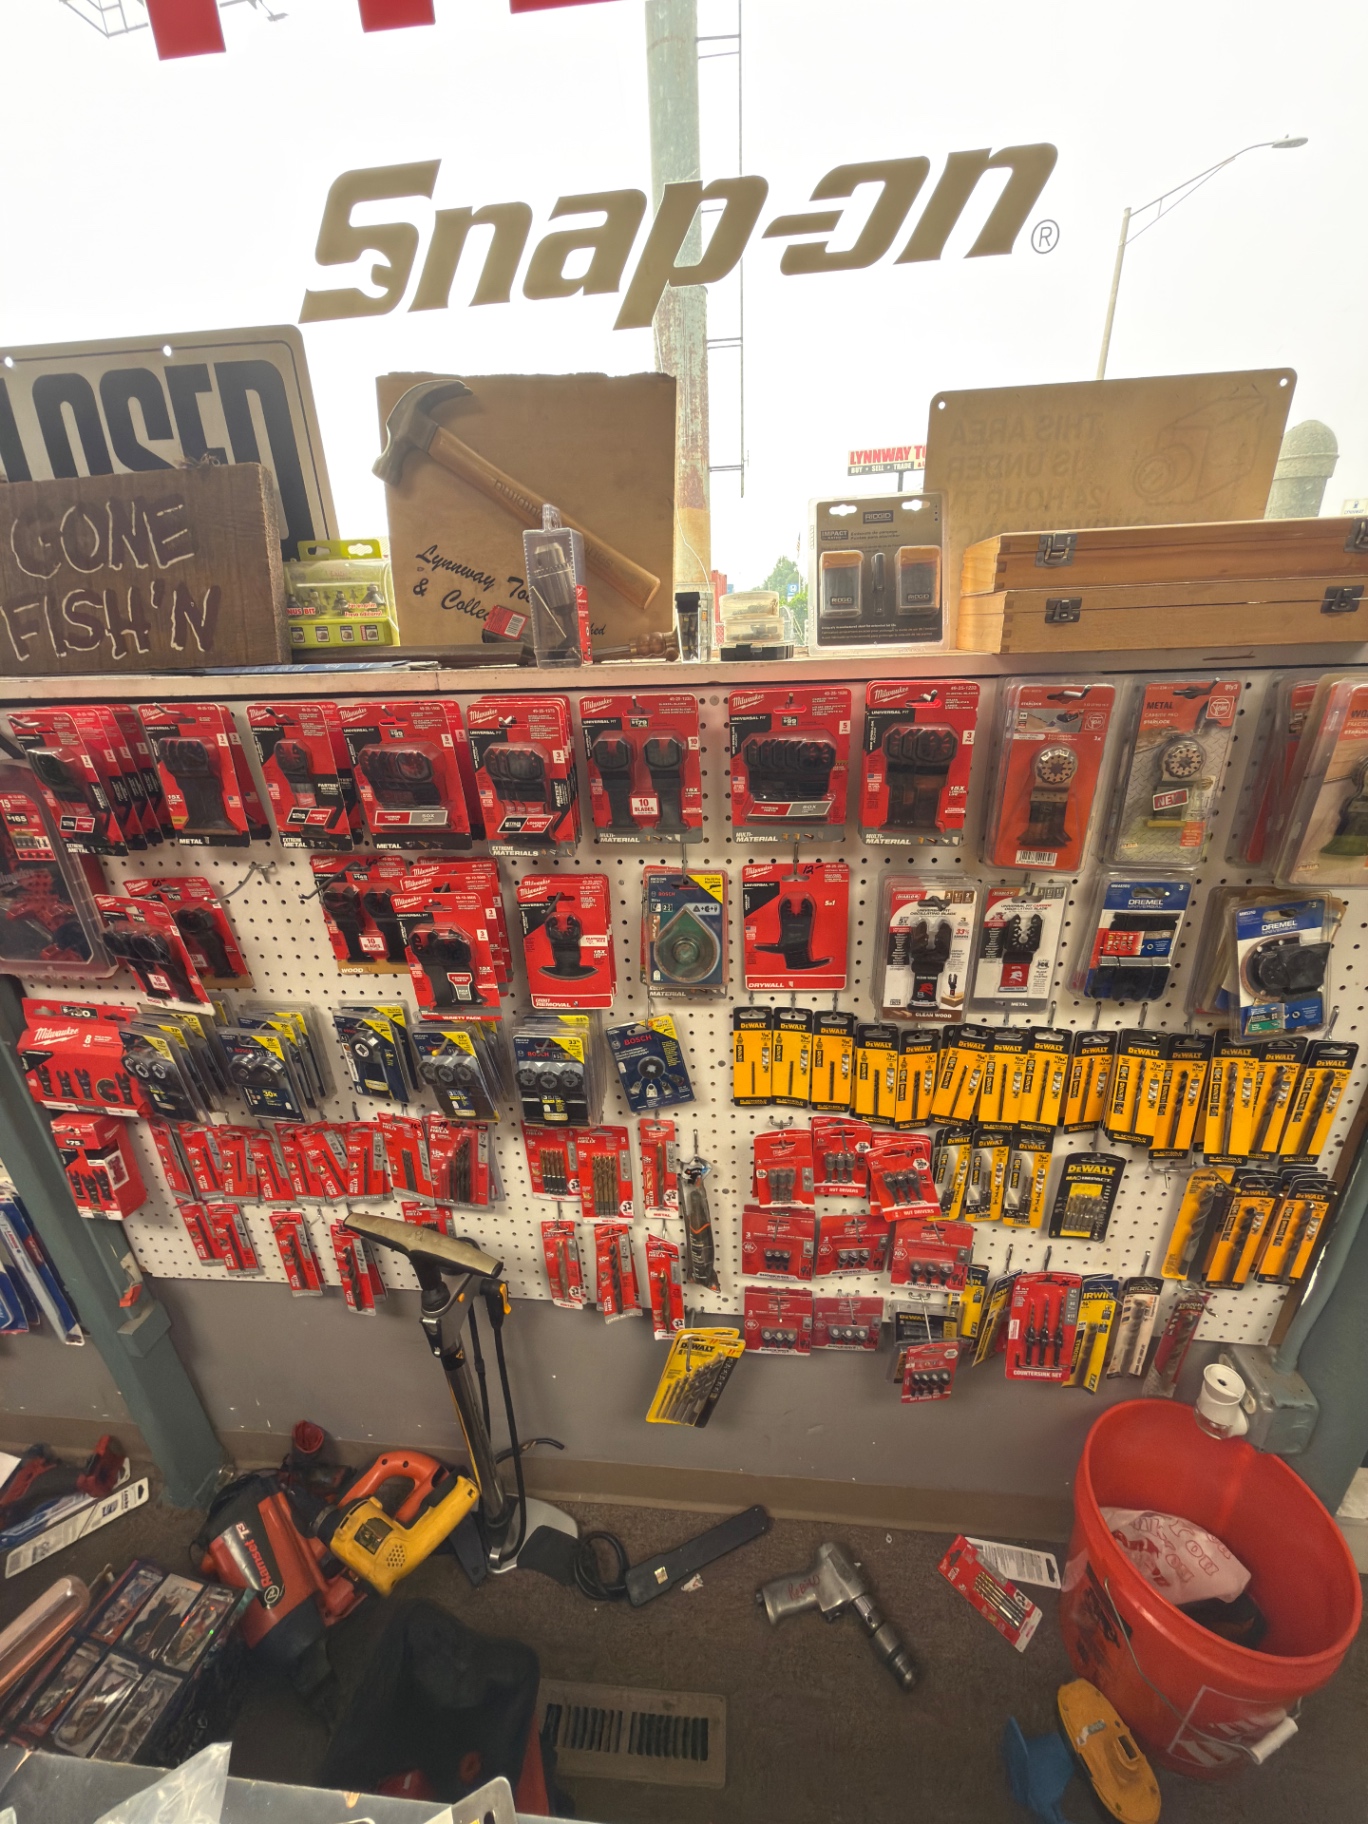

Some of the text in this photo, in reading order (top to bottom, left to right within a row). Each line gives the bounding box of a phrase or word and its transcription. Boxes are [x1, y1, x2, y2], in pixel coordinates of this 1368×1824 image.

[299, 143, 1058, 330] Snap-on
[850, 446, 912, 465] LYNNWAY
[864, 512, 892, 520] RIDGID
[11, 501, 195, 579] GONE
[416, 544, 496, 589] Lynnway
[413, 578, 428, 596] &
[303, 607, 315, 615] BIT
[0, 580, 212, 661] FISH'N
[874, 686, 909, 702] Milwaukee
[582, 697, 613, 713] Milwaukee
[733, 693, 765, 710] Milwaukee
[1146, 701, 1174, 710] METAL
[340, 707, 367, 720] Milwaukee
[470, 708, 498, 724] Milwaukee
[6, 815, 27, 823] $165
[412, 865, 440, 877] Milwaukee
[744, 865, 773, 878] Milwaukee
[404, 877, 432, 891] Milwaukee
[519, 886, 547, 899] Milwaukee
[394, 895, 423, 908] Milwaukee
[1261, 920, 1298, 931] DREMEL
[34, 1026, 80, 1043] Milwaukee
[84, 1034, 91, 1044] 8
[624, 1034, 653, 1047] BOSCH
[680, 1341, 716, 1353] DWALT
[1013, 1370, 1051, 1378] COUNTERSINK
[244, 1538, 273, 1588] Ramset
